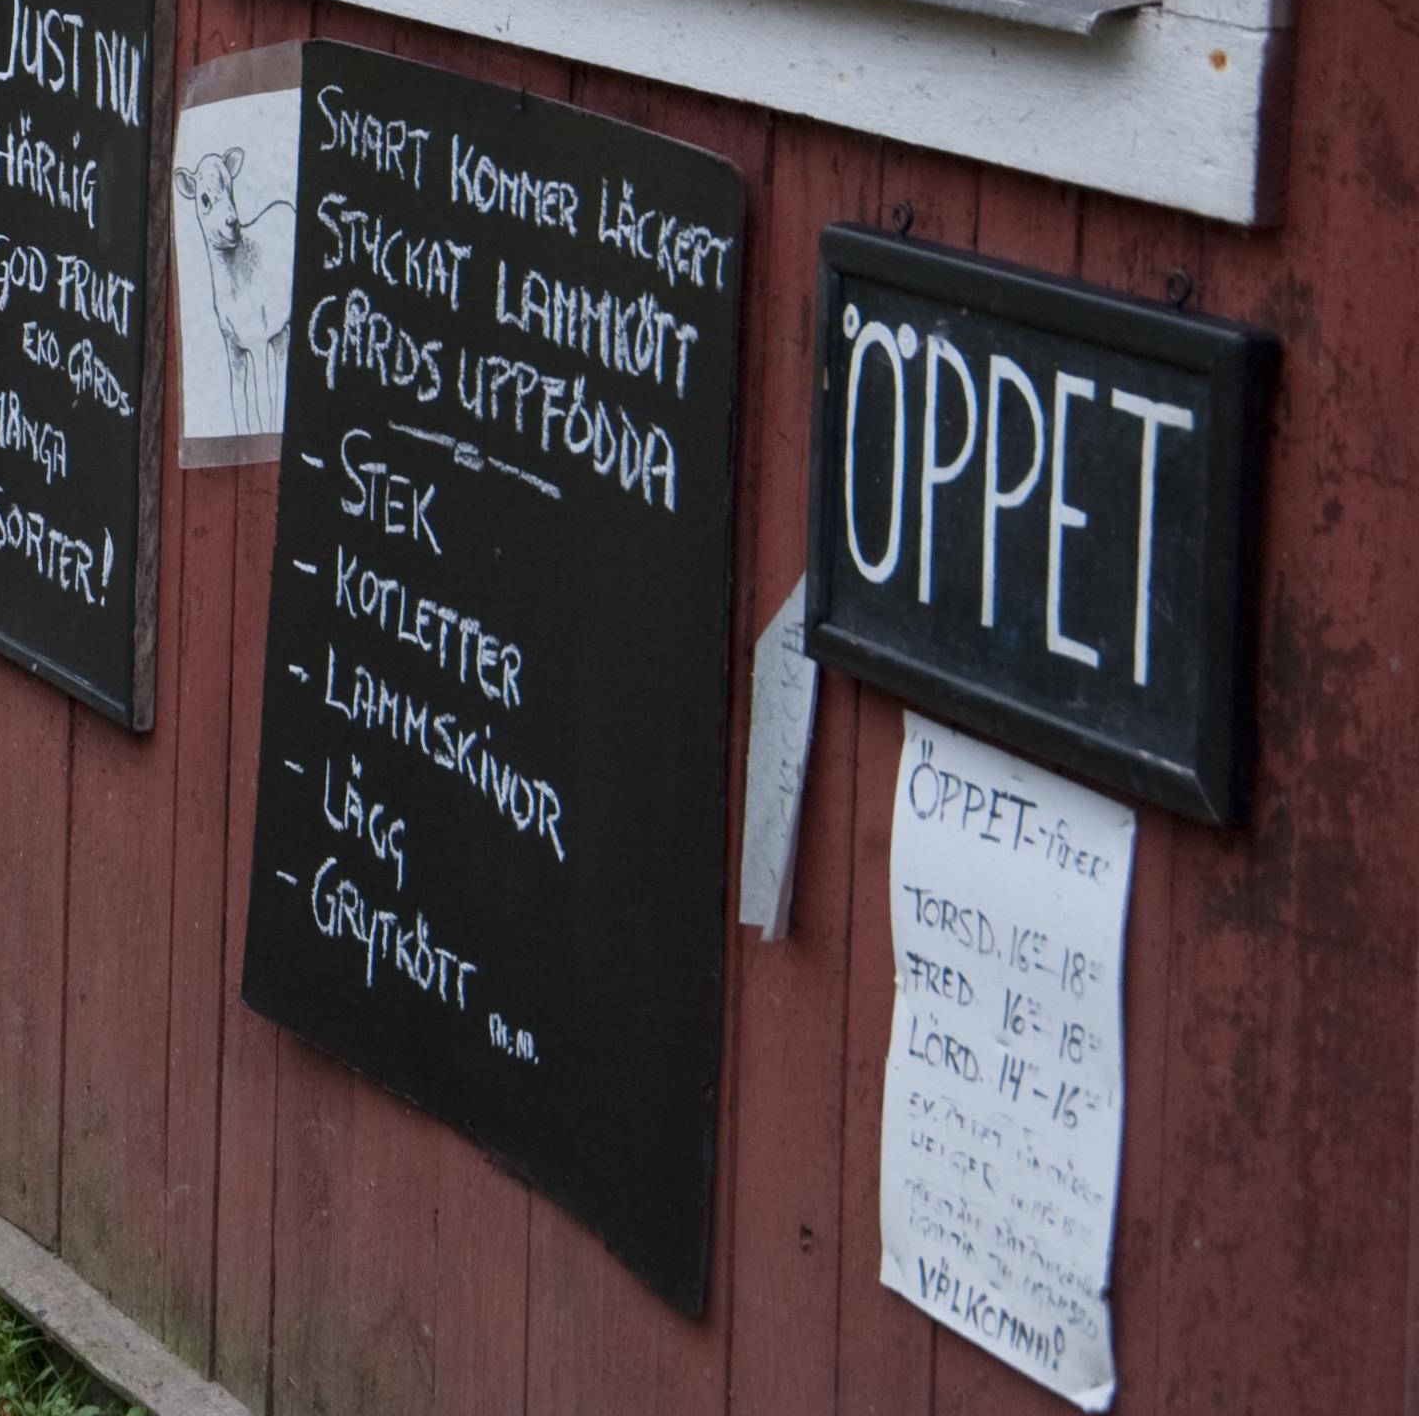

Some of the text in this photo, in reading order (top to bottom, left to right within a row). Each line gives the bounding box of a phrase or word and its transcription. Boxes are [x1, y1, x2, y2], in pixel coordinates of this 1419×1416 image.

[316, 84, 734, 293] SNART KOMMER LÄCKERT
[56, 254, 135, 337] FRUKT
[317, 193, 699, 399] STYCKAT LAMMKÖTT
[307, 289, 677, 513] GÅRDS UPPFÖDDA
[339, 428, 442, 555] STEK
[842, 303, 1194, 686] ÖPPET
[334, 544, 522, 709] KOTLETTER
[322, 753, 406, 892] LÄGG
[311, 856, 478, 1011] GRYTKÖTT
